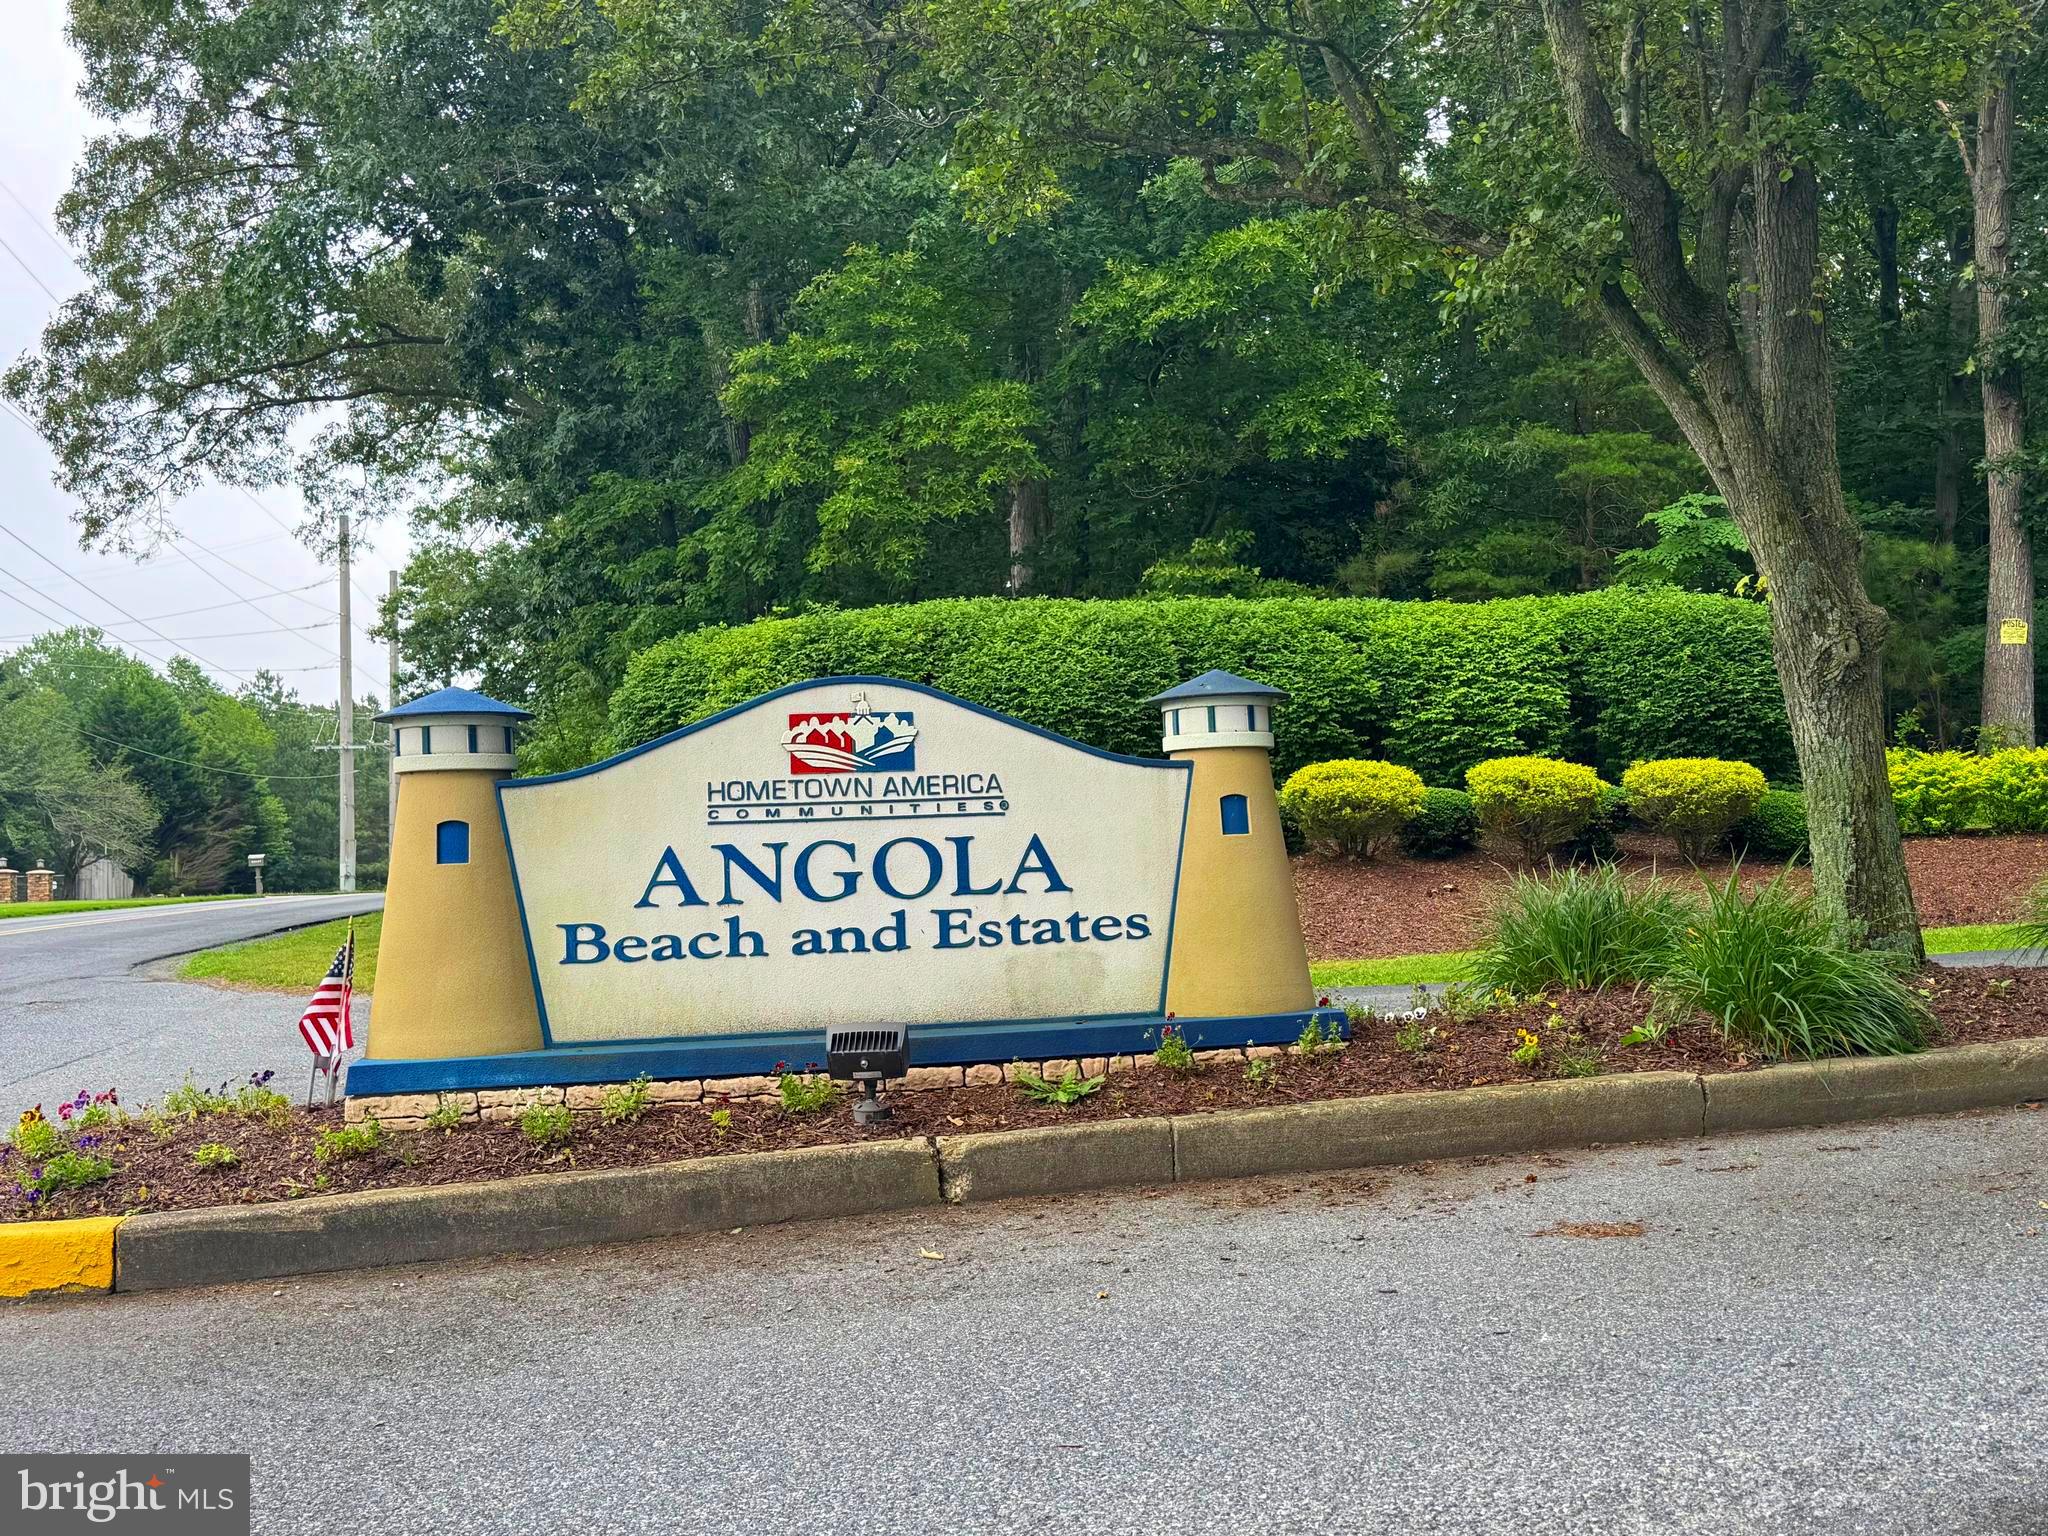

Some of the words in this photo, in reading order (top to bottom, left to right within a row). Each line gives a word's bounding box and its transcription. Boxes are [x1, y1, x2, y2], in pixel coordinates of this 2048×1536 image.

[707, 776, 873, 802] HOMETOWN
[882, 773, 1004, 798] AMERICA
[634, 832, 1074, 908] ANGOLA
[556, 914, 769, 965] Beach
[791, 909, 911, 956] and
[930, 908, 1152, 950] Estates
